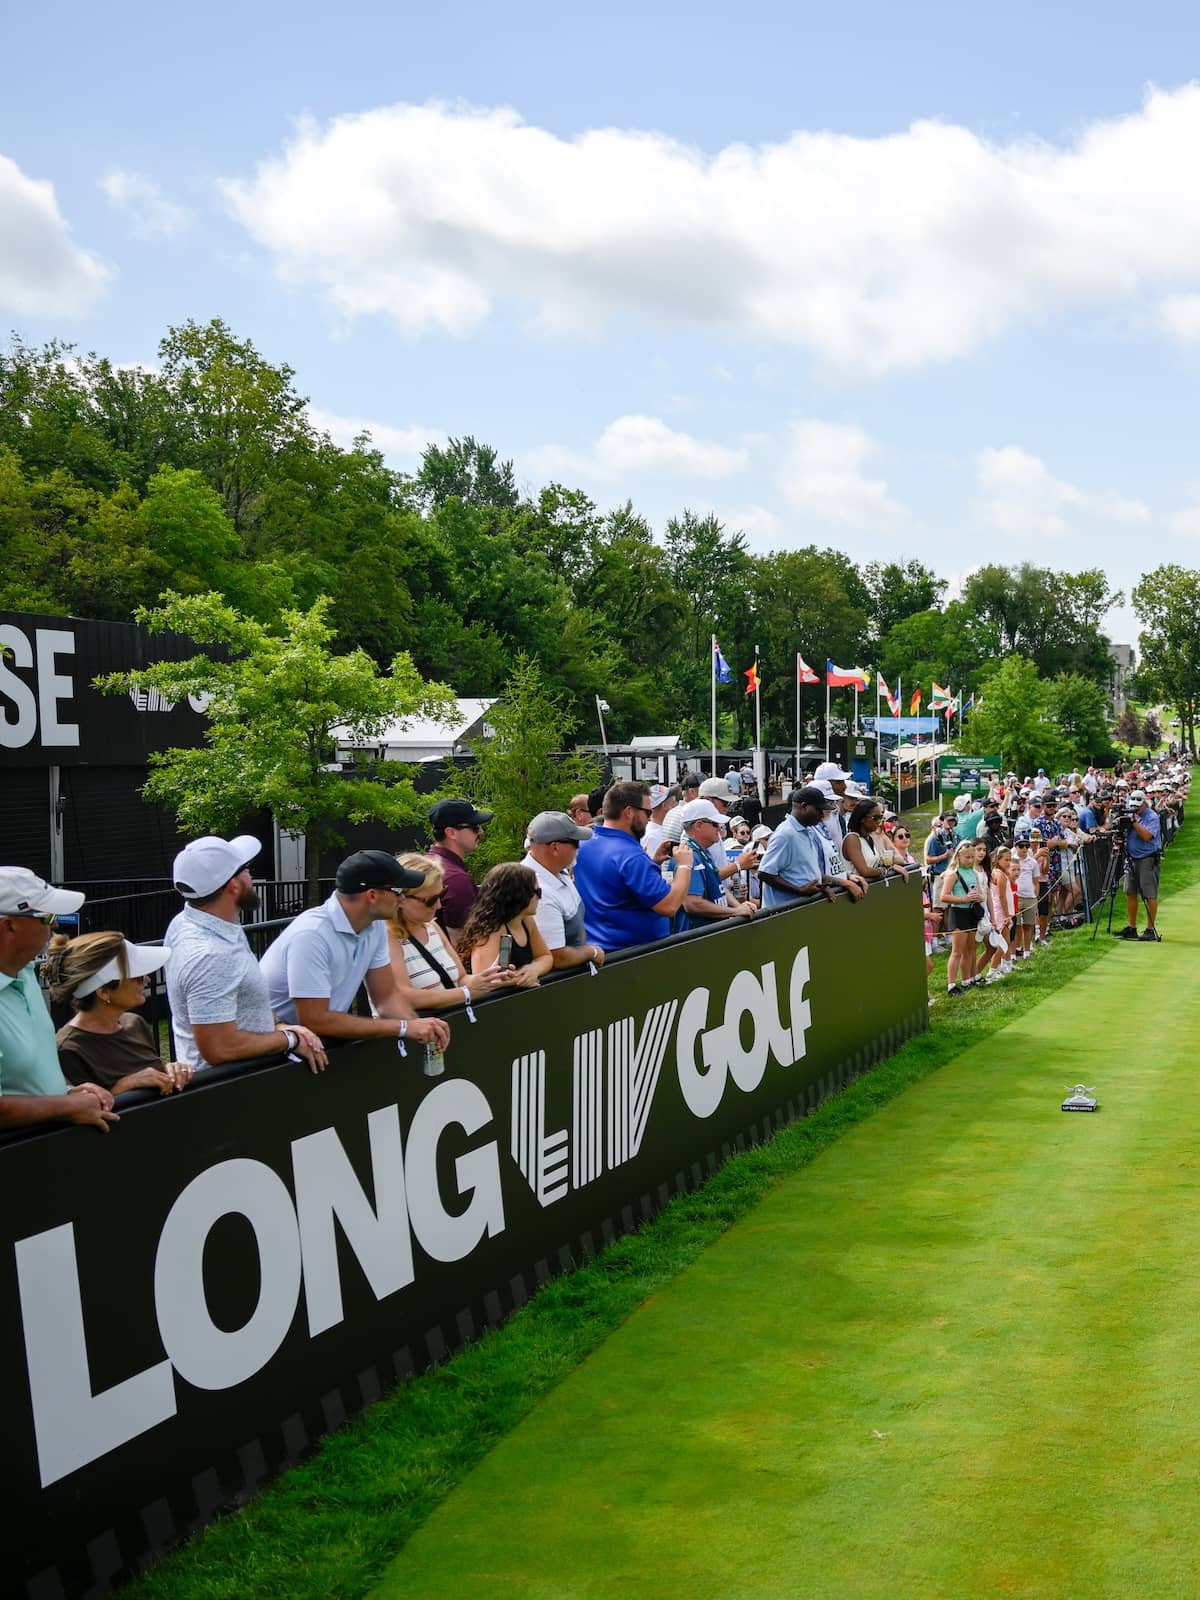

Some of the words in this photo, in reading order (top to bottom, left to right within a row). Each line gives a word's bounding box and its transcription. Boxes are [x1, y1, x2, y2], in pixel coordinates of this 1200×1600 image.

[15, 1078, 506, 1490] LONG
[510, 999, 679, 1209] LIV
[676, 946, 813, 1118] GOLF
